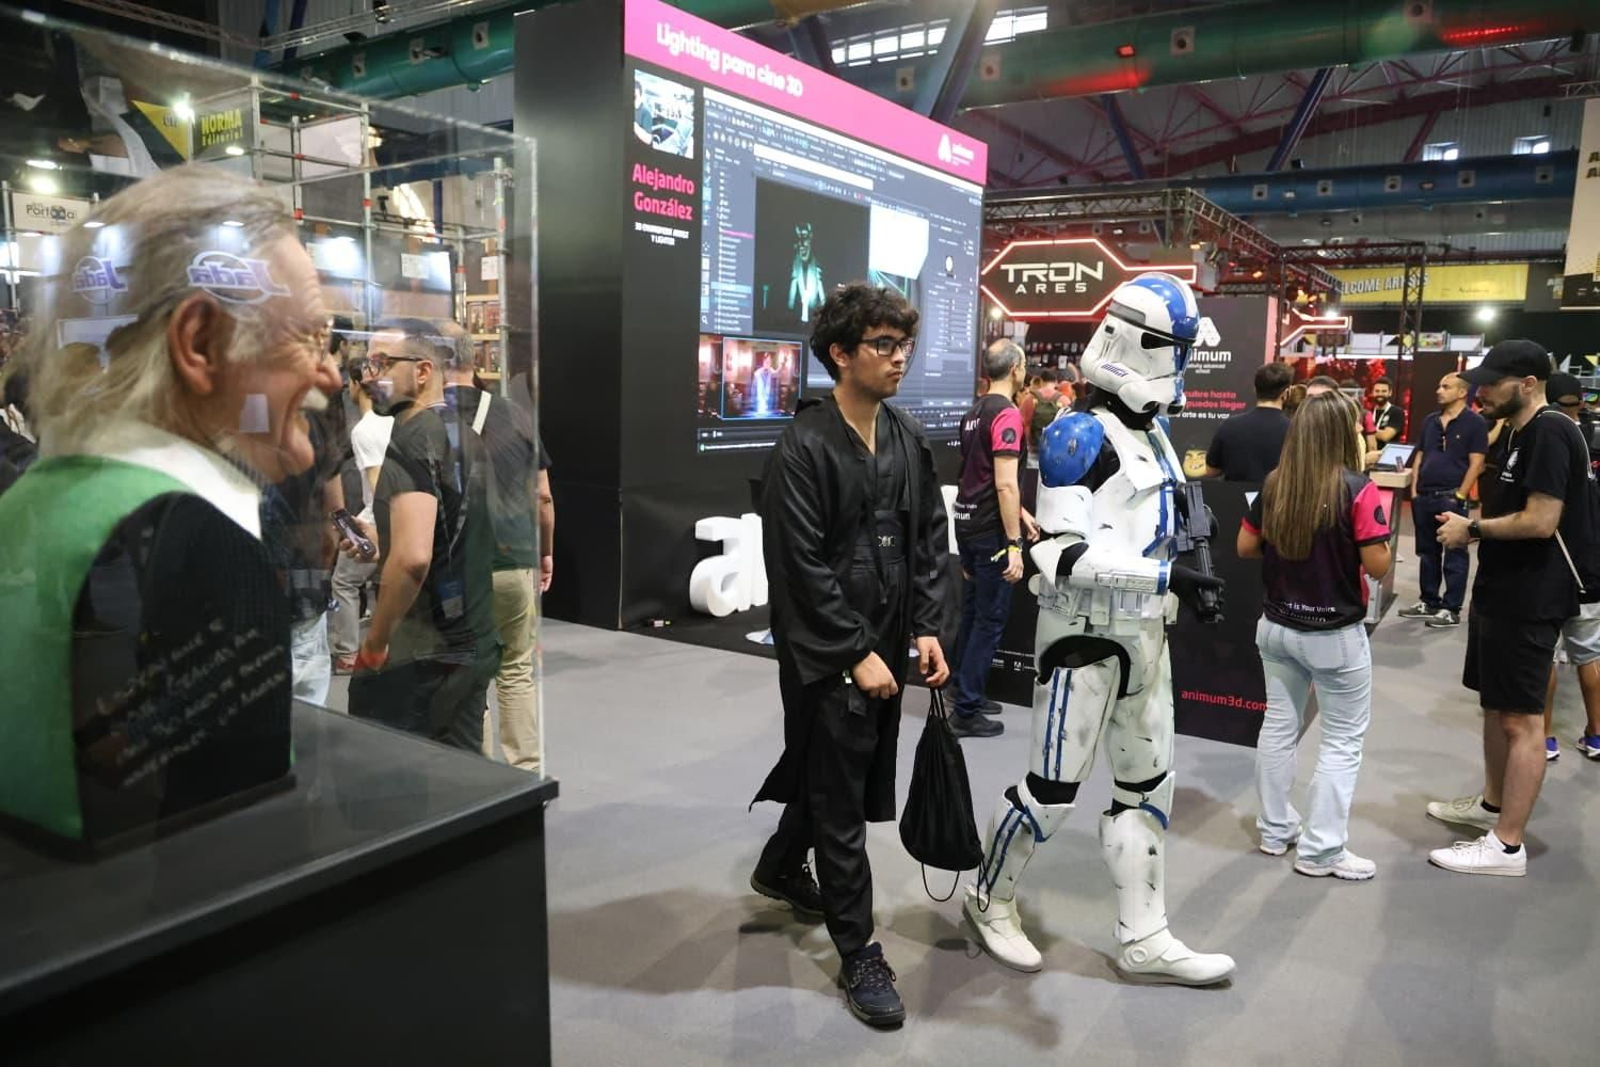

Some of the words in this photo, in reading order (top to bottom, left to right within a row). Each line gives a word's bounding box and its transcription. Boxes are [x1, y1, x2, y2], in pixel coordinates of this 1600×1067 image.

[656, 22, 721, 71] Lighting
[721, 51, 756, 80] para
[757, 64, 786, 92] cine
[786, 74, 803, 97] 3D
[201, 108, 243, 135] NORMA
[202, 127, 243, 146] Editorial
[632, 163, 695, 195] Alejandro
[634, 191, 693, 220] González
[1000, 261, 1103, 283] TRON
[1015, 282, 1087, 294] ARES
[1221, 401, 1246, 411] llegar
